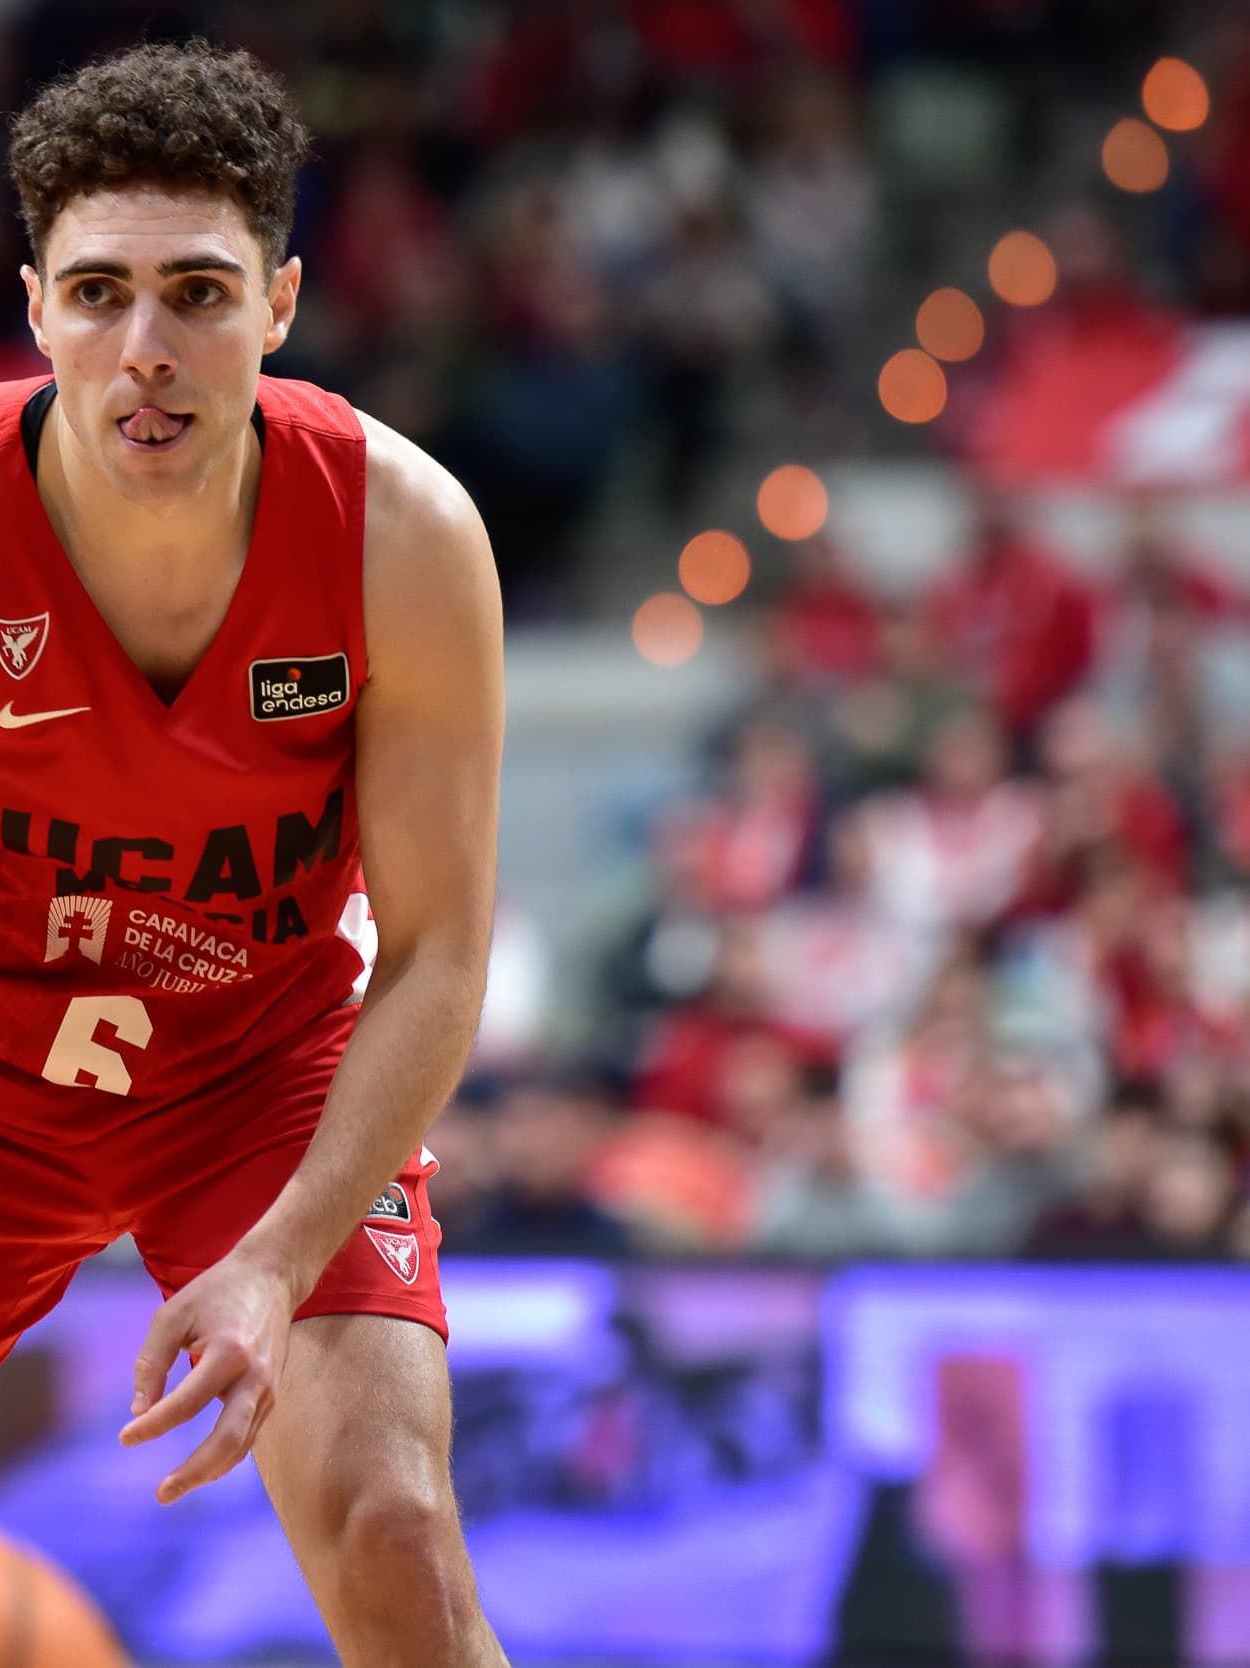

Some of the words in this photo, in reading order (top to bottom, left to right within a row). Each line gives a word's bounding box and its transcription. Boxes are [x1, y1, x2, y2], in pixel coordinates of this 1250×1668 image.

[6, 625, 32, 635] UCAM
[261, 680, 298, 698] liga
[262, 690, 342, 713] endesa
[1, 785, 344, 902] UCAM
[128, 909, 249, 968] CARAVACA
[114, 950, 153, 978] AÑO
[124, 927, 153, 952] DE
[153, 938, 175, 963] LA
[177, 953, 238, 984] CRUZ
[369, 1195, 397, 1214] cb
